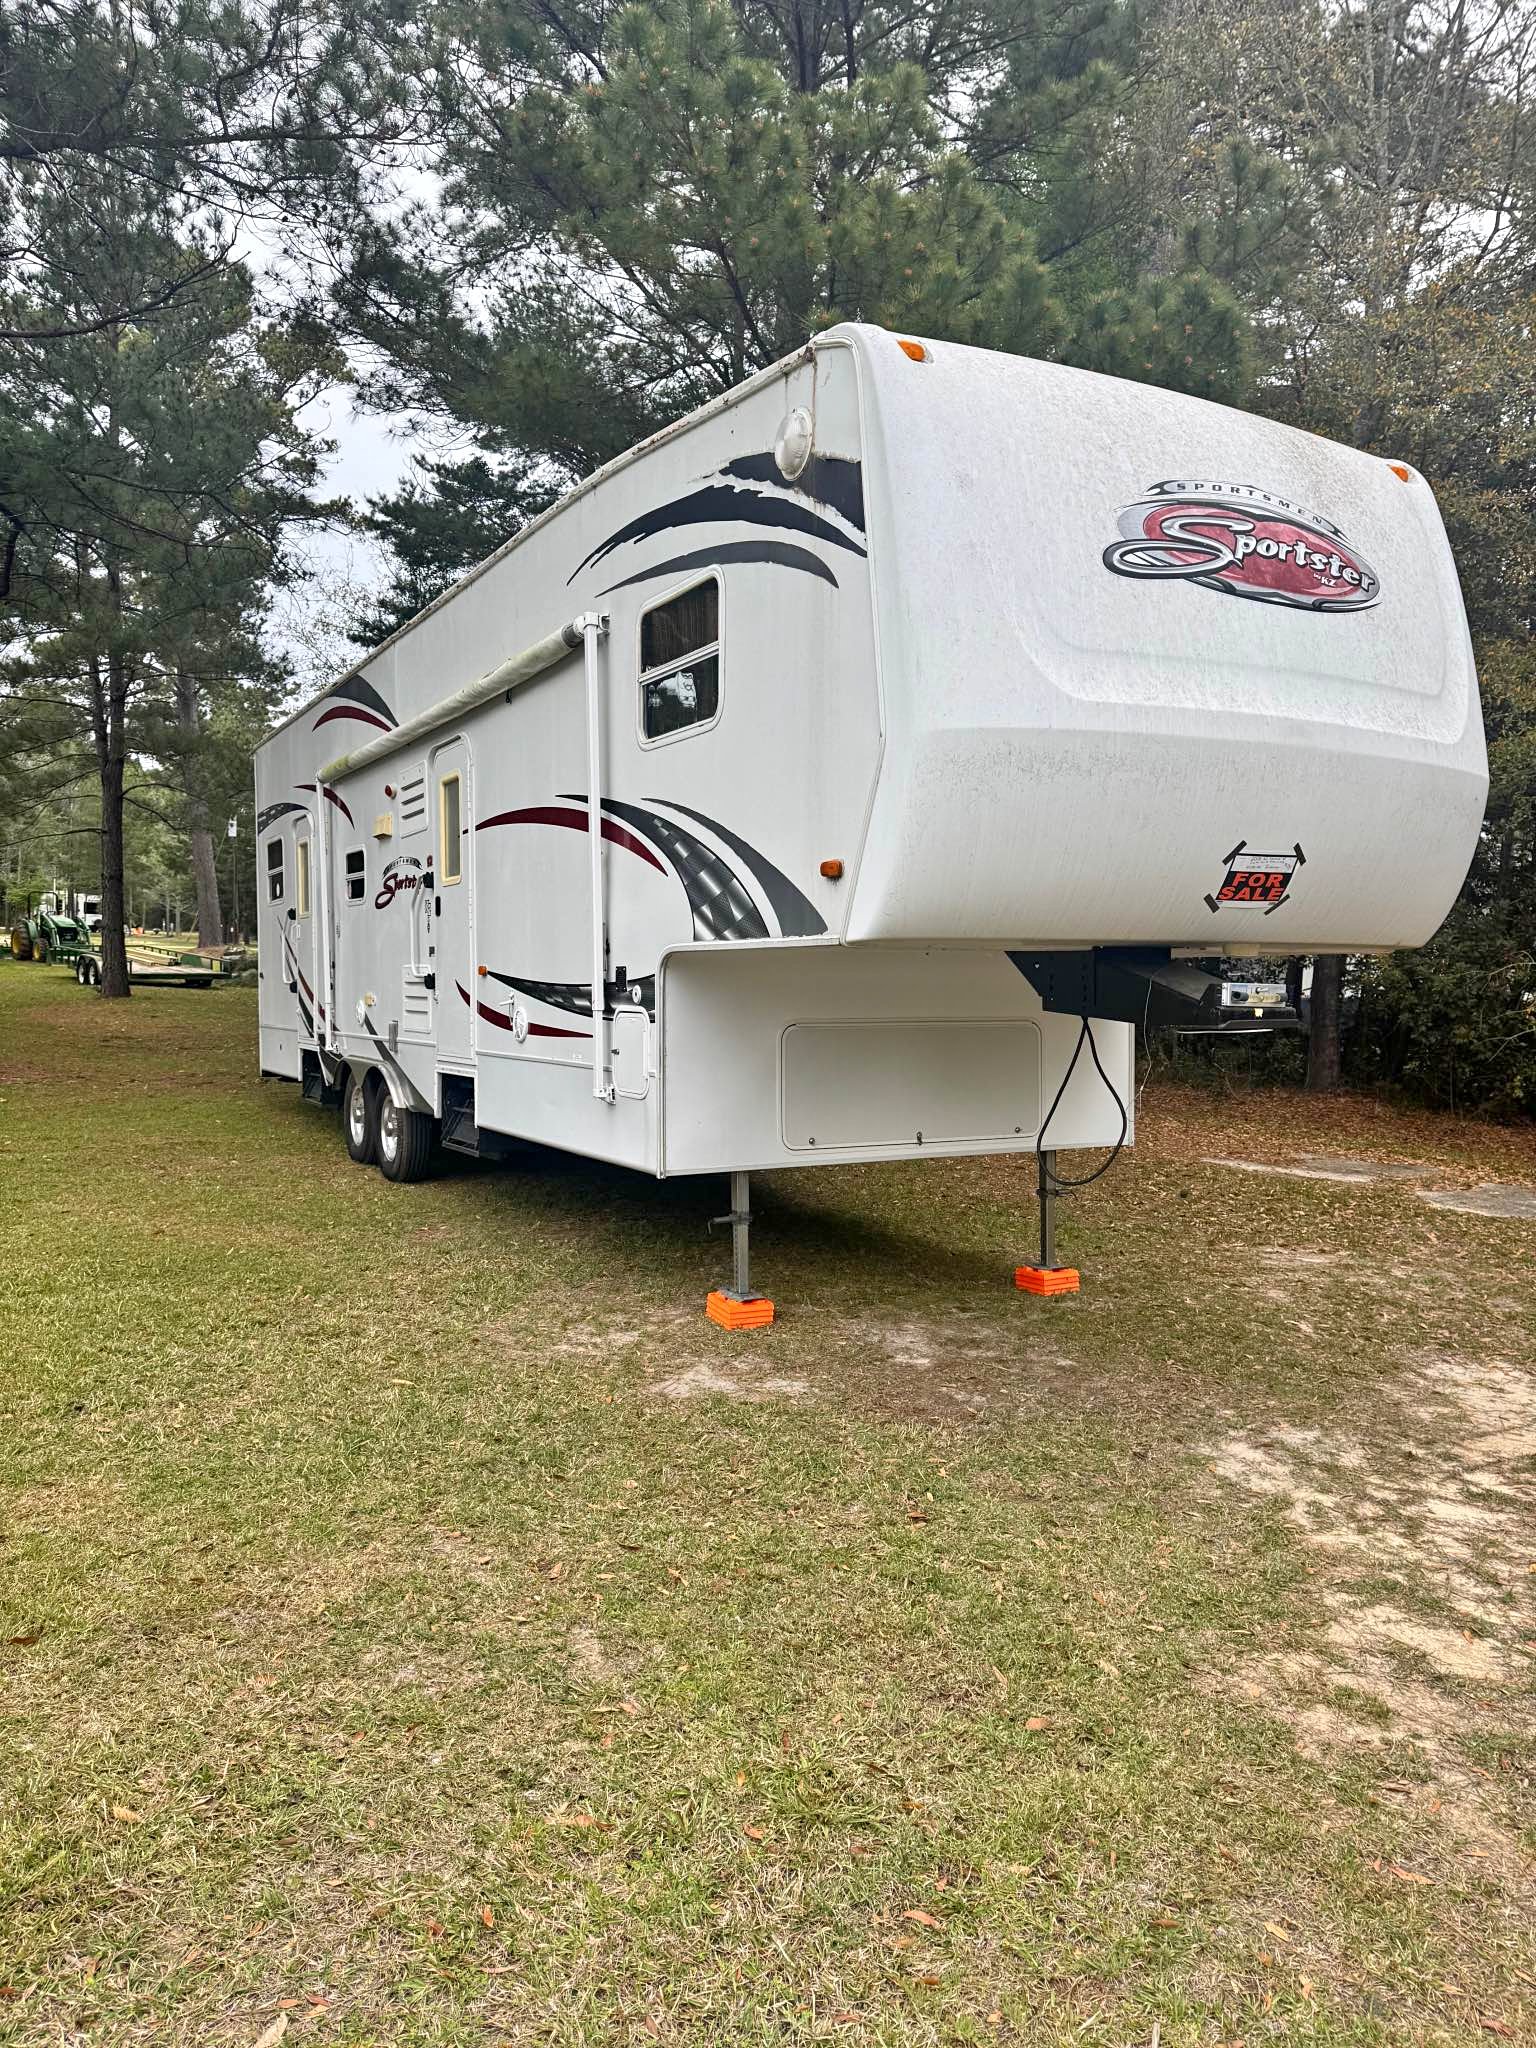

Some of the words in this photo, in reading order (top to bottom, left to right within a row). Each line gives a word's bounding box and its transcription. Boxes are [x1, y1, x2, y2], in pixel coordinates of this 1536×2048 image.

[1176, 481, 1323, 524] SPORTSMEN
[1103, 514, 1375, 592] Sportster
[1321, 576, 1337, 588] KZ
[1232, 873, 1284, 887] FOR
[1219, 887, 1284, 900] SALE
